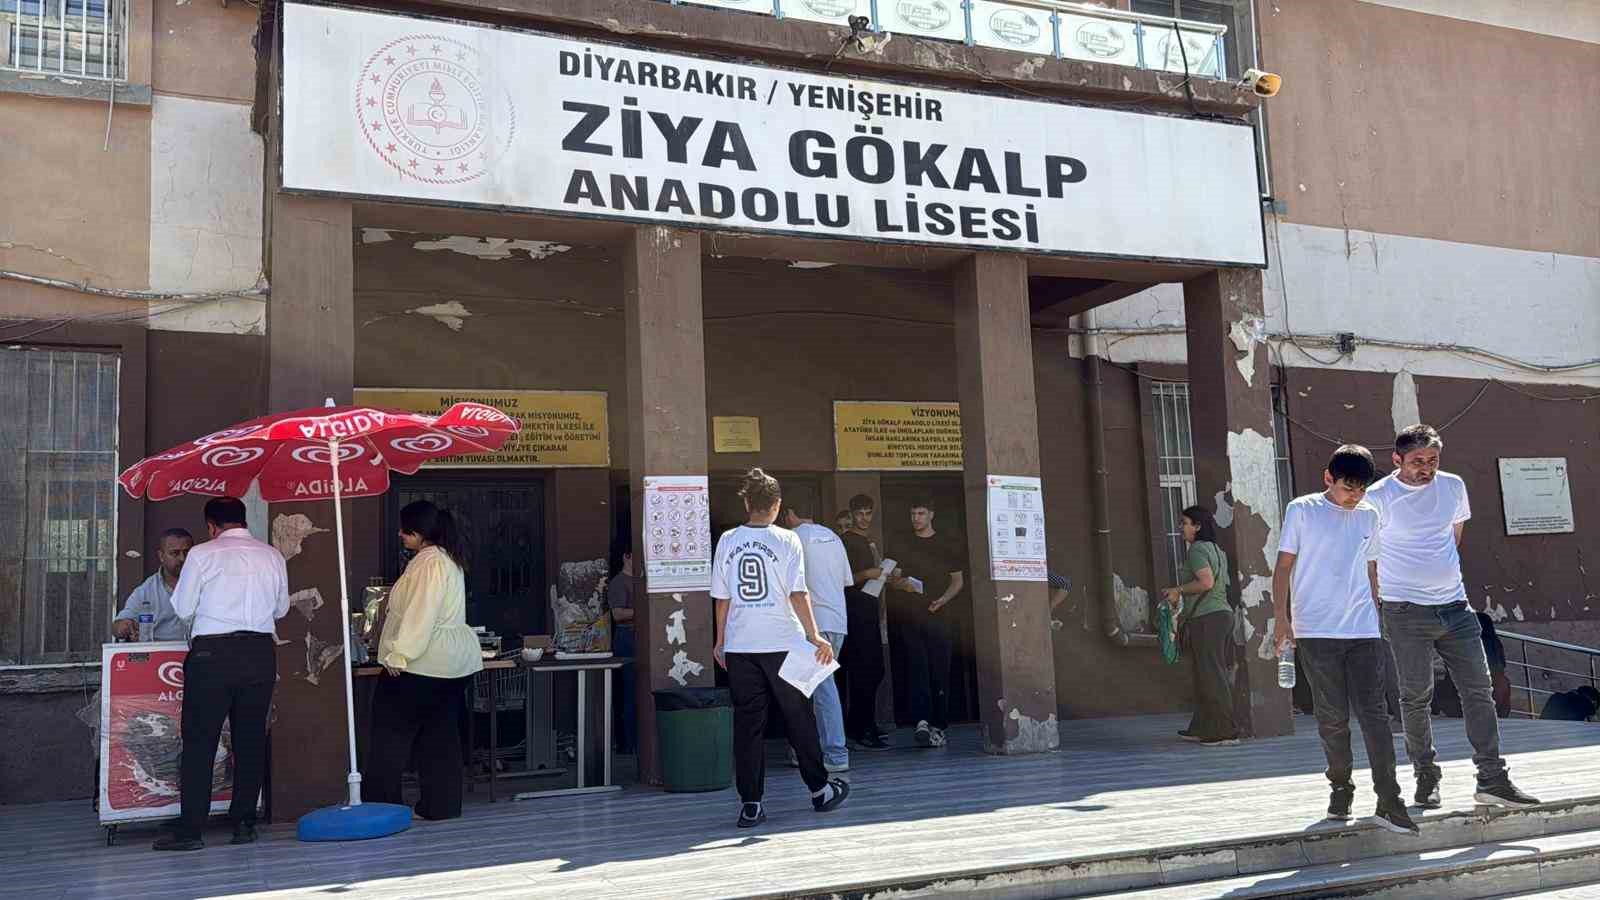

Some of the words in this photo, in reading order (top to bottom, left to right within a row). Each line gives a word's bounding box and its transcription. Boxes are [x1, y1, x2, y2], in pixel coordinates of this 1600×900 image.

[560, 48, 755, 105] DİYARBAKIR
[766, 80, 778, 106] /
[789, 83, 942, 121] YENİŞEHİR
[562, 96, 757, 171] ZİYA
[788, 124, 1087, 199] GÖKALP
[563, 169, 850, 228] ANADOLU
[875, 192, 1039, 244] LİSESİ
[911, 406, 960, 418] VİZYONUMU
[753, 541, 779, 562] FIRST
[738, 553, 768, 601] 9
[158, 690, 184, 702] ALG
